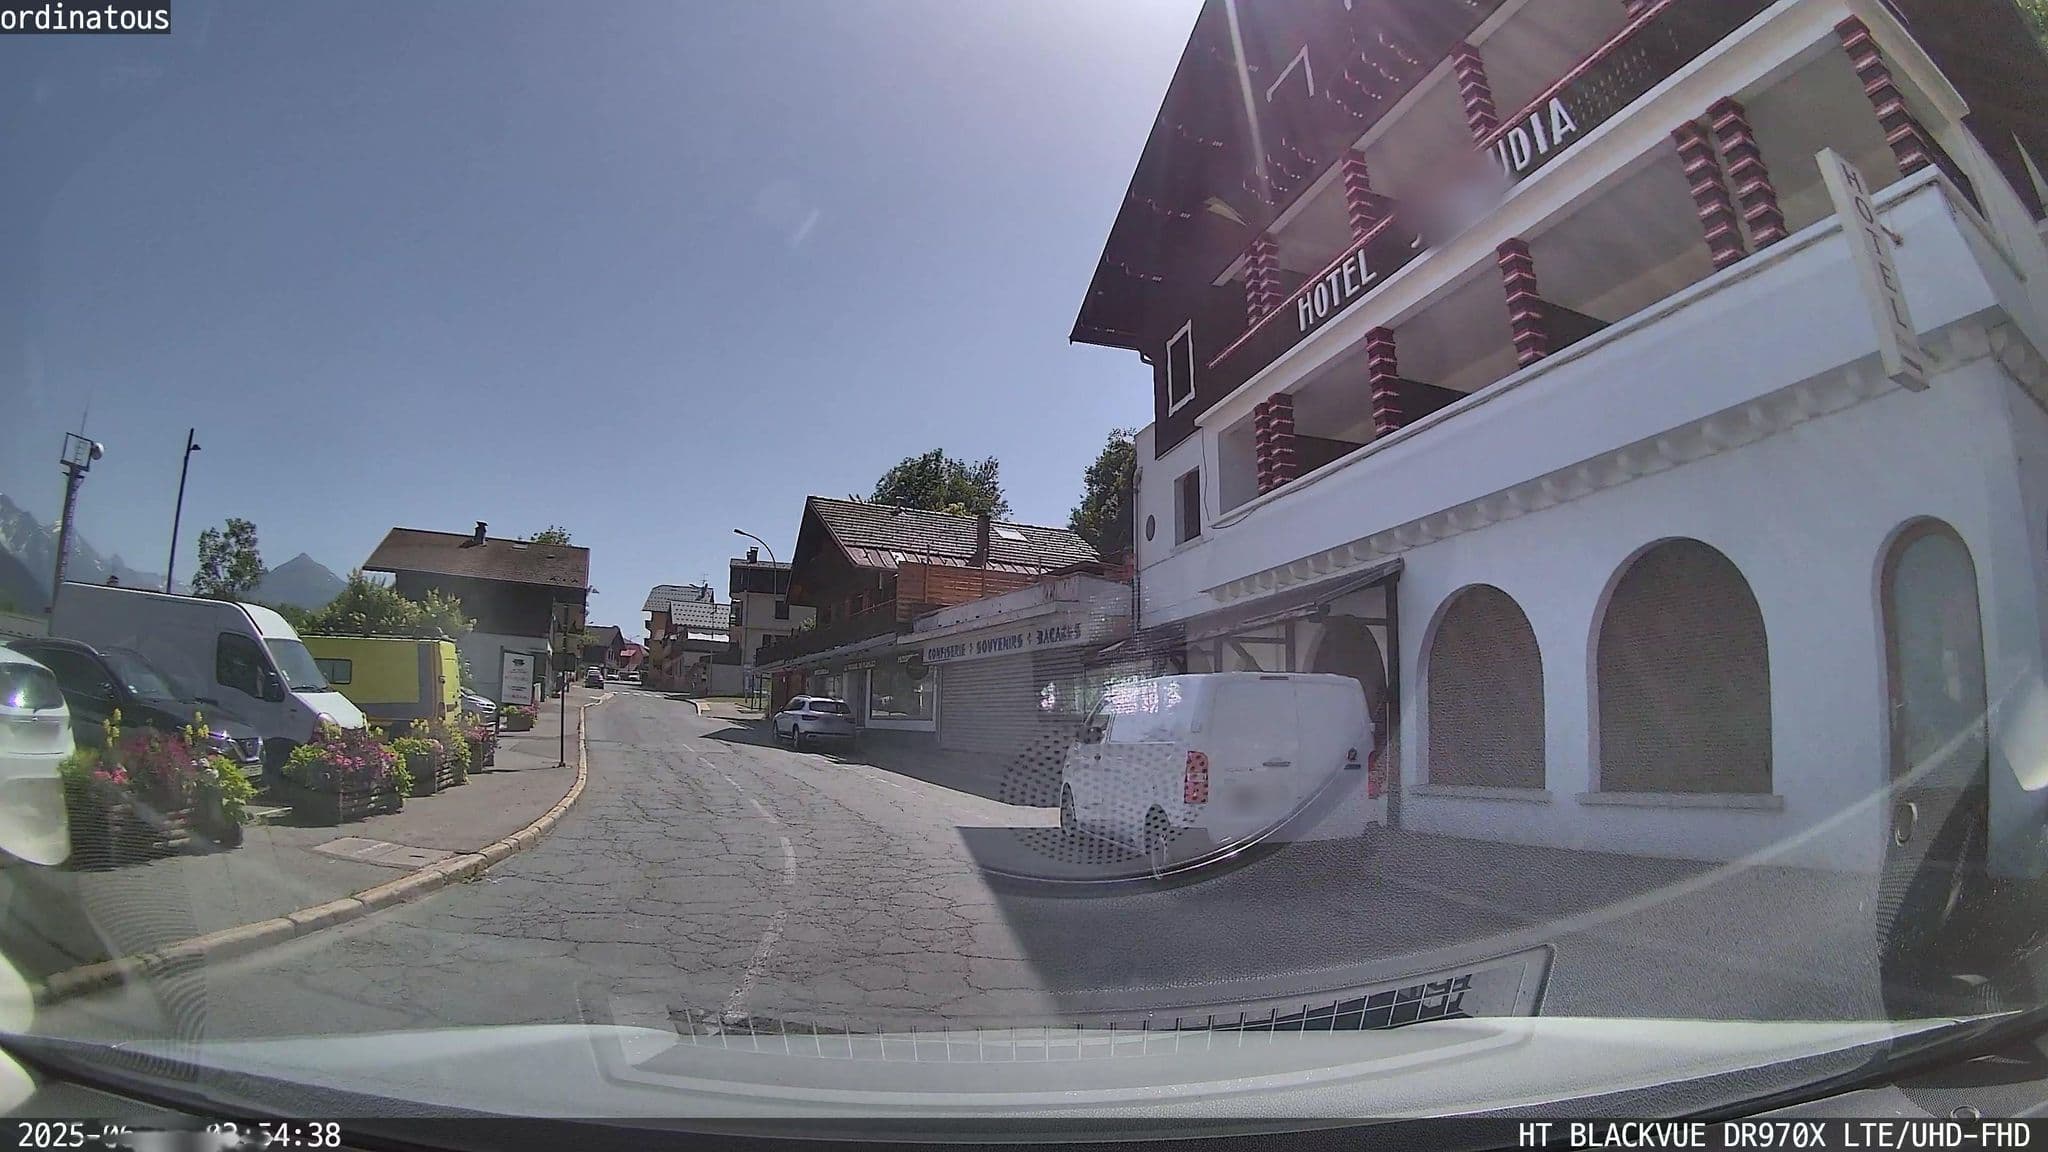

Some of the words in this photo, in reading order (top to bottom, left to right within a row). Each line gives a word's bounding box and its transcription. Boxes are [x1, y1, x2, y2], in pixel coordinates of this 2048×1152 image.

[1840, 162, 1908, 329] HOTEL
[1298, 248, 1377, 332] HOTEL
[927, 643, 966, 661] CONFISERIE
[976, 633, 1023, 655] SOUVENIRS
